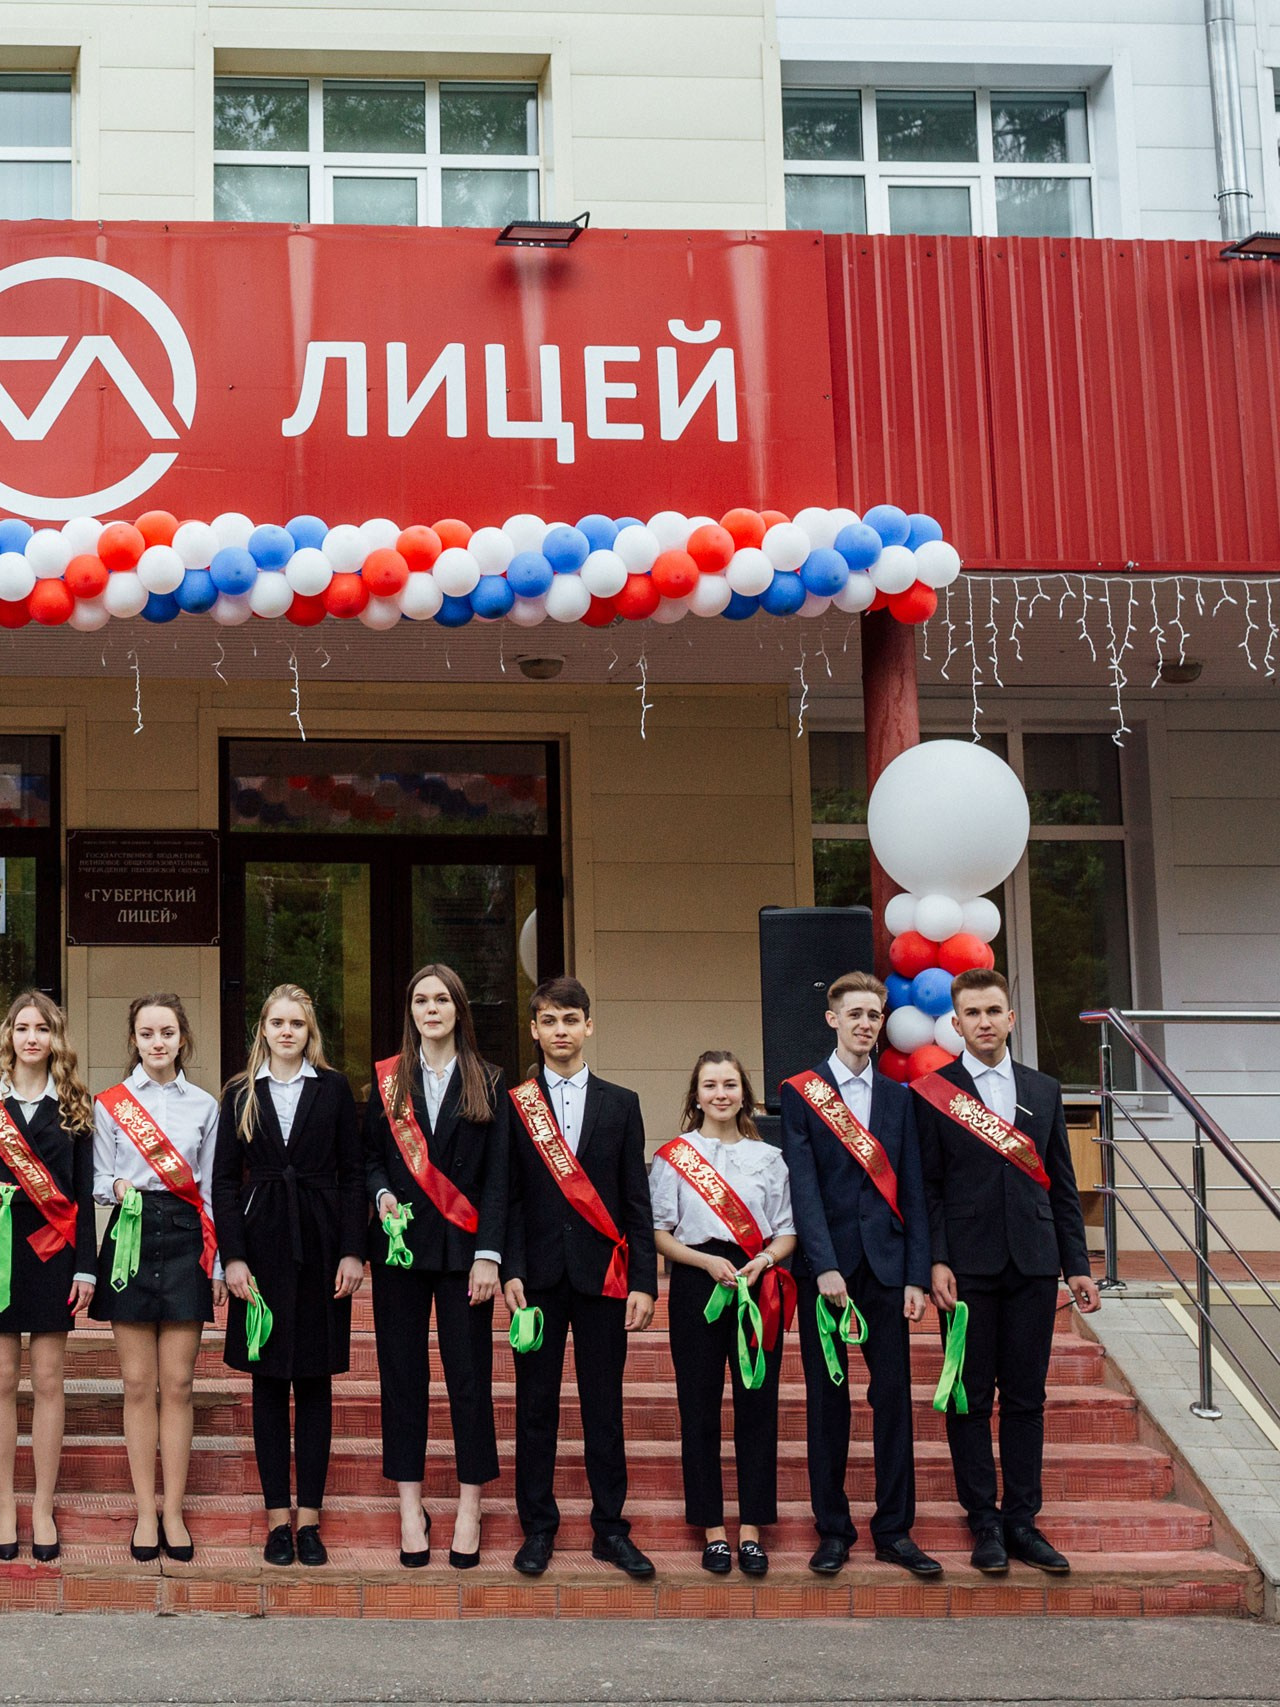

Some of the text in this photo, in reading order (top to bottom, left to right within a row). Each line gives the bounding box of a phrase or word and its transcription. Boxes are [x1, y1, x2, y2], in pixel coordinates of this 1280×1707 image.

[280, 318, 739, 464] ЛИЦЕЙ
[84, 887, 197, 903] «ГУБЕРНСКИЙ
[117, 907, 178, 924] ЛИЦЕЙ»
